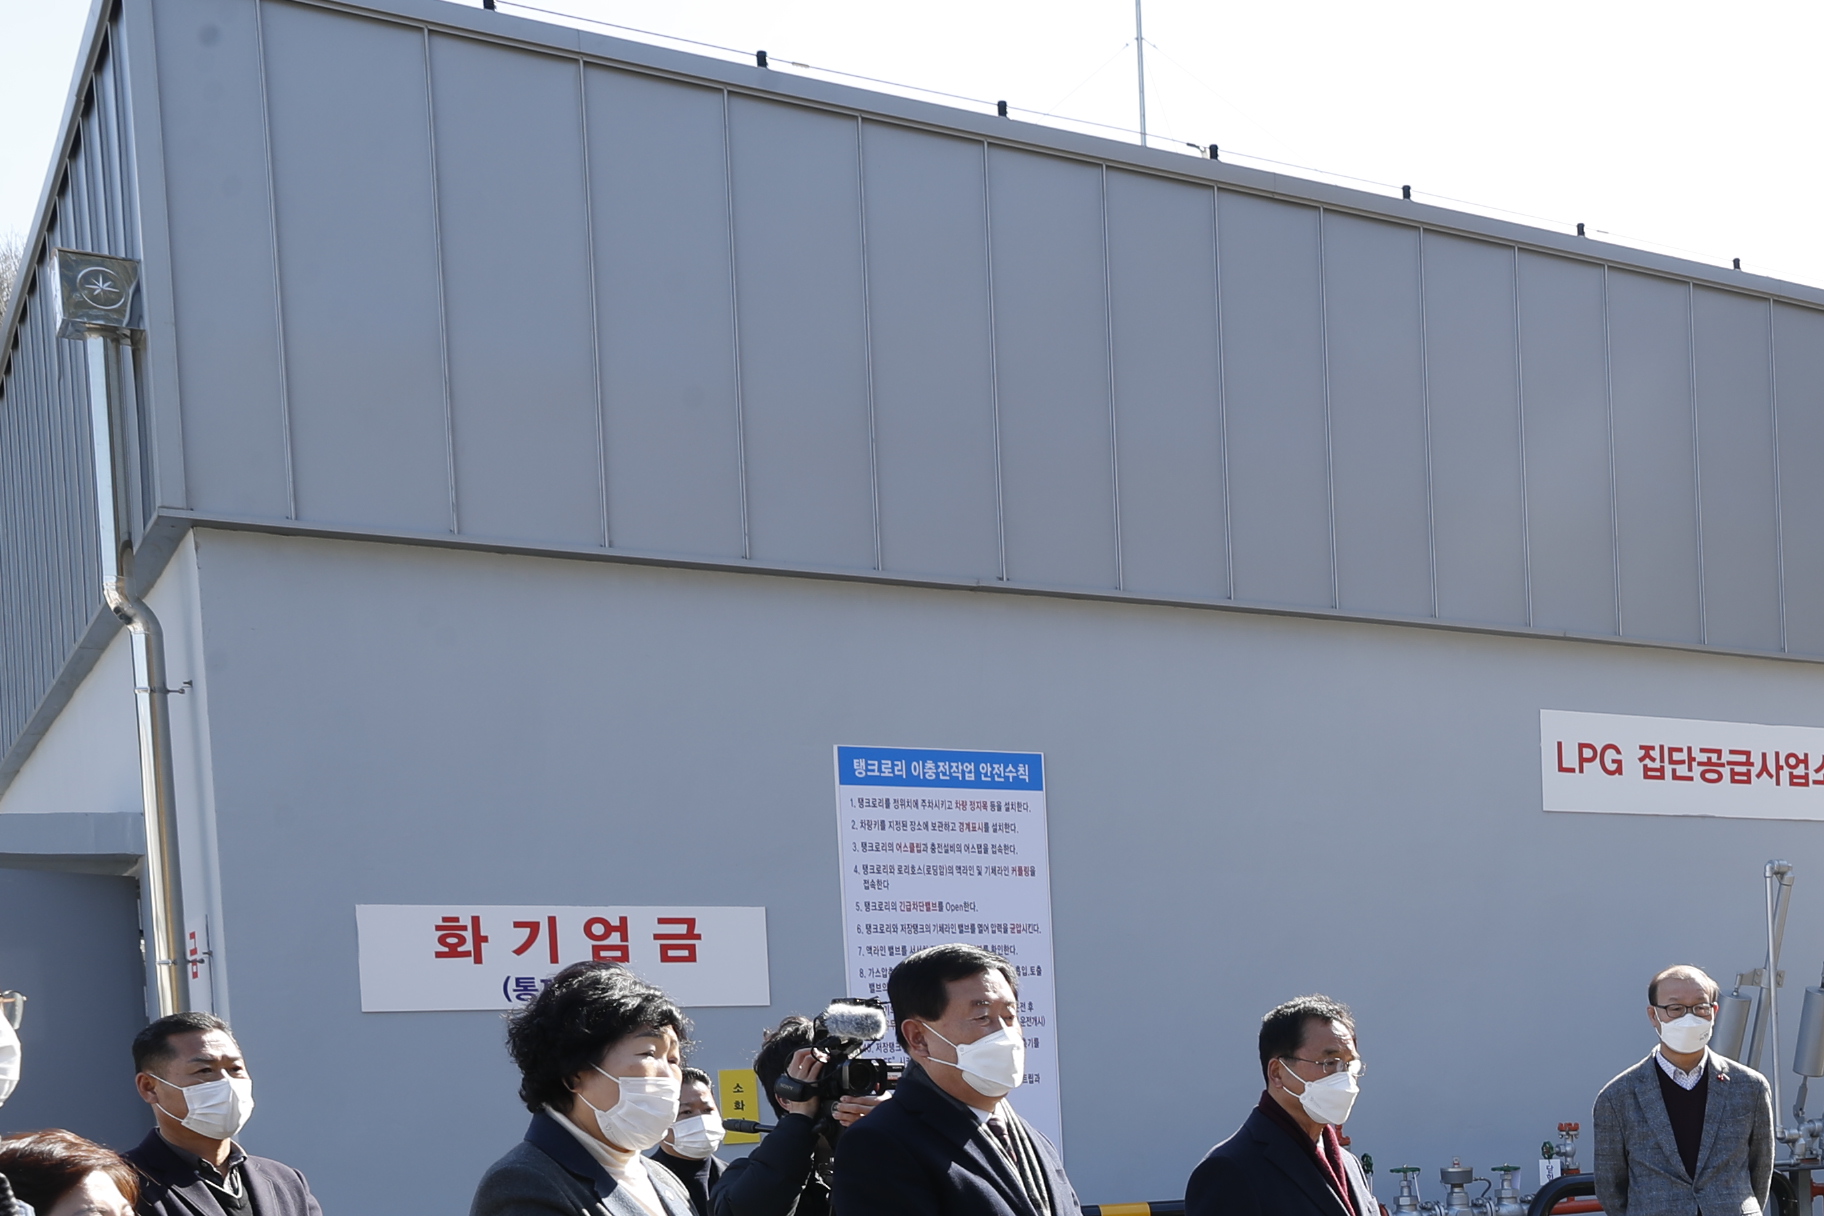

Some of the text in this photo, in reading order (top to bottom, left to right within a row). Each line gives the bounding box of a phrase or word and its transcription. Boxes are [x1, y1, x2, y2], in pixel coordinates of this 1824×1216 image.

[1556, 741, 1623, 776] LPG
[853, 758, 1029, 783] 탱크로리 이충전작업 안전수칙
[850, 798, 856, 808] 1.
[857, 797, 891, 809] 탱크로리를
[892, 798, 919, 810] 정위치에
[921, 799, 953, 810] 주차시키고
[954, 800, 968, 811] 차량
[990, 800, 1002, 812] 등을
[1004, 801, 1031, 813] 설치한다.
[851, 819, 858, 830] 2.
[860, 820, 886, 831] 차량키를
[888, 820, 908, 832] 지정된
[910, 820, 929, 832] 장소에
[931, 821, 956, 832] 보관하고
[991, 822, 1019, 834] 설치한다.
[852, 842, 859, 852] 3.
[861, 842, 894, 853] 탱크로리의
[990, 843, 1018, 855] 접속한다.
[854, 864, 860, 875] 4.
[862, 864, 895, 876] 탱크로리와
[863, 879, 890, 890] 접속한다
[856, 902, 862, 912] 5.
[864, 901, 897, 912] 탱크로리의
[946, 901, 978, 912] Open한다.
[856, 924, 864, 934] 6.
[865, 924, 898, 935] 탱크로리와
[900, 924, 931, 935] 저장탱크의
[434, 915, 702, 965] 화기엄금
[858, 946, 864, 956] 7.
[888, 945, 907, 956] 밸브를
[859, 968, 866, 978] 8.
